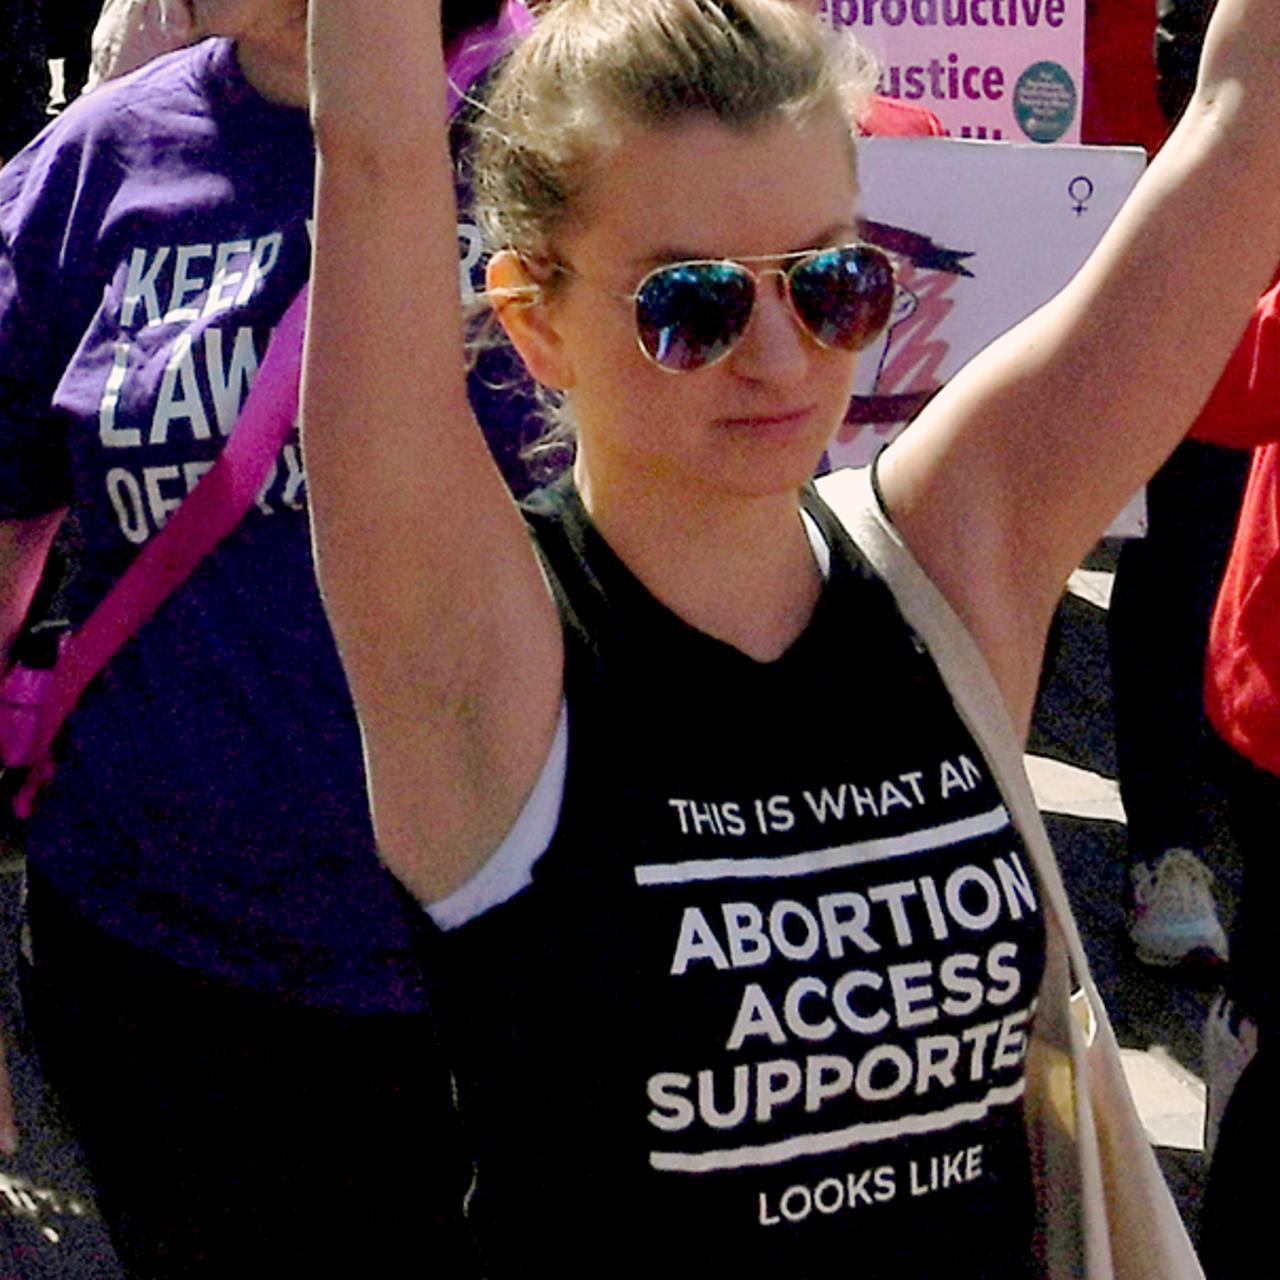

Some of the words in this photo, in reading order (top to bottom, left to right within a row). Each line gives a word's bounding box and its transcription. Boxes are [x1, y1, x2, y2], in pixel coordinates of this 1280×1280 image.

[669, 798, 748, 837] THIS
[754, 793, 796, 834] IS
[803, 771, 926, 826] WHAT
[669, 850, 1038, 977] ABORTION
[725, 940, 1022, 1051] ACCESS
[758, 1164, 898, 1227] LOOKS
[909, 1143, 985, 1198] LIKE
